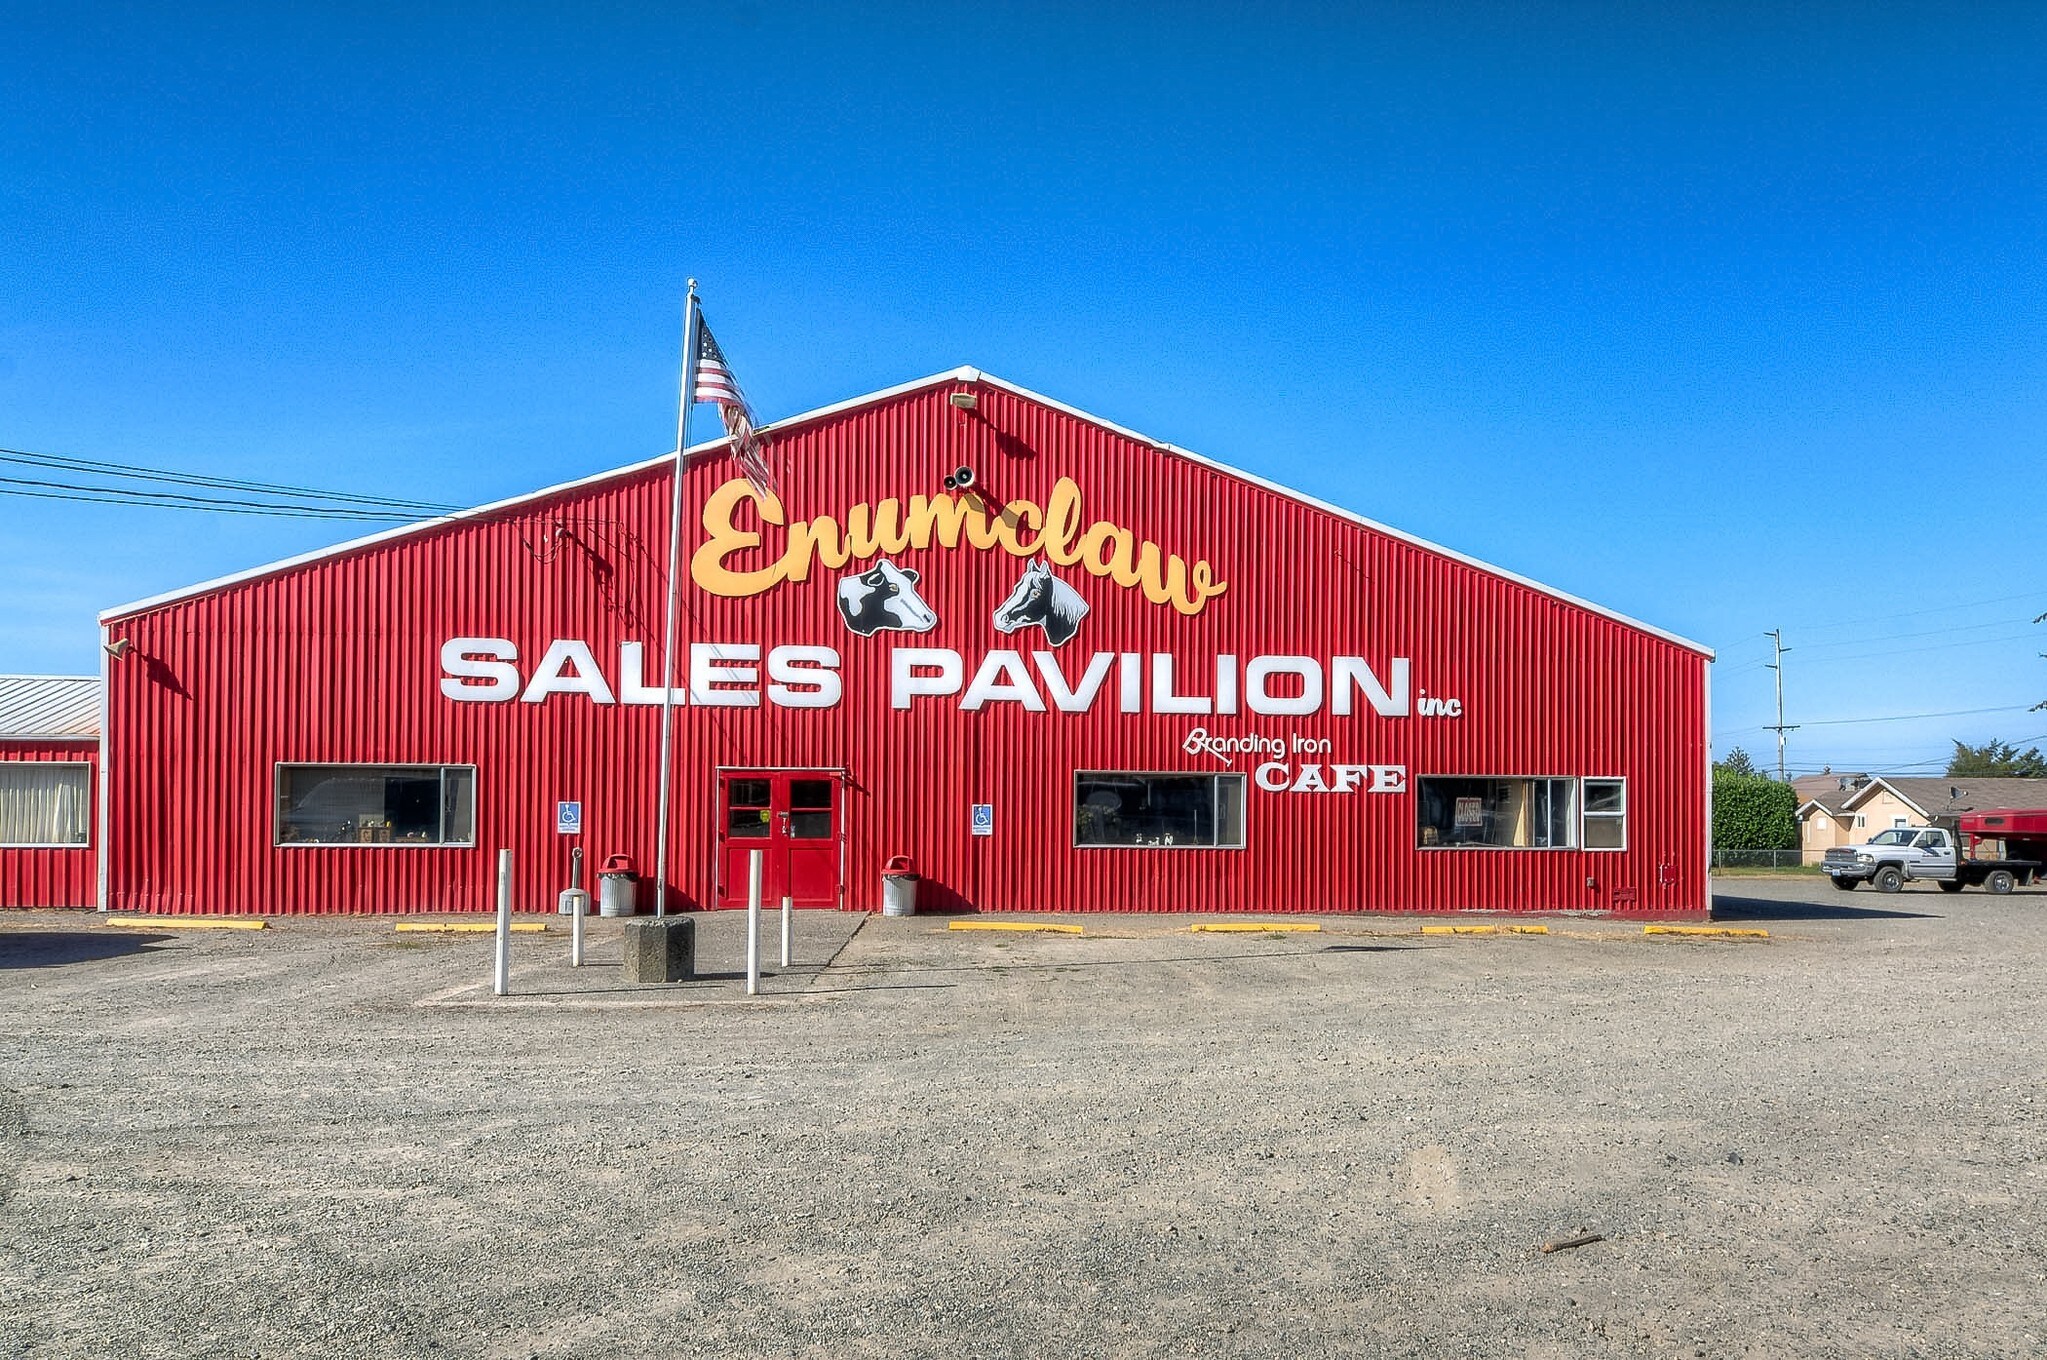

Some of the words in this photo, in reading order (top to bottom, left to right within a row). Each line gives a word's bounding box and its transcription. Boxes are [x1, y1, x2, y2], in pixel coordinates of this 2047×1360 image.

[691, 478, 1227, 615] Enumclaw
[440, 638, 841, 708] SALES
[891, 648, 1410, 716] PAVILION
[1417, 689, 1462, 717] inc
[1182, 728, 1285, 766] Branding
[1293, 733, 1331, 753] Iron
[1255, 762, 1406, 793] CAFE
